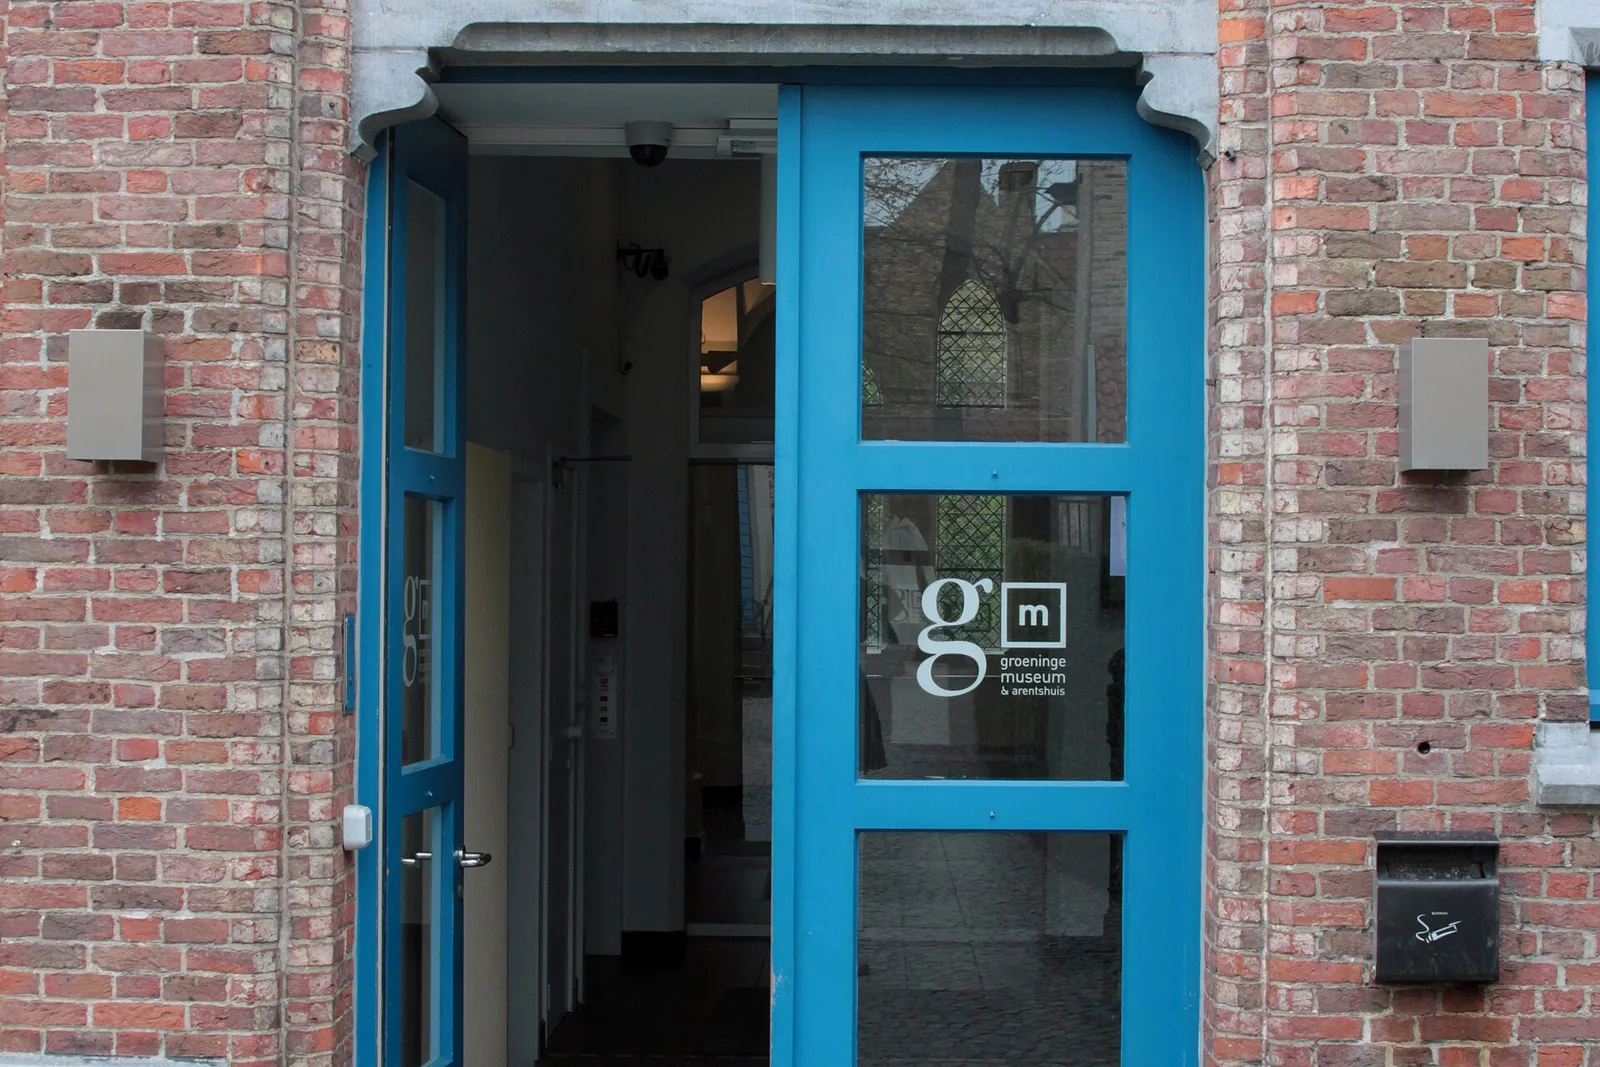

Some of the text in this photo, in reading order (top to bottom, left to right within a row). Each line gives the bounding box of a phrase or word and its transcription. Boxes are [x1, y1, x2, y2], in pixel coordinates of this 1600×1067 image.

[916, 578, 993, 697] g
[1018, 604, 1049, 627] m
[1000, 654, 1067, 671] groeninge
[1000, 672, 1066, 684] museum
[1011, 685, 1066, 696] arentshuis
